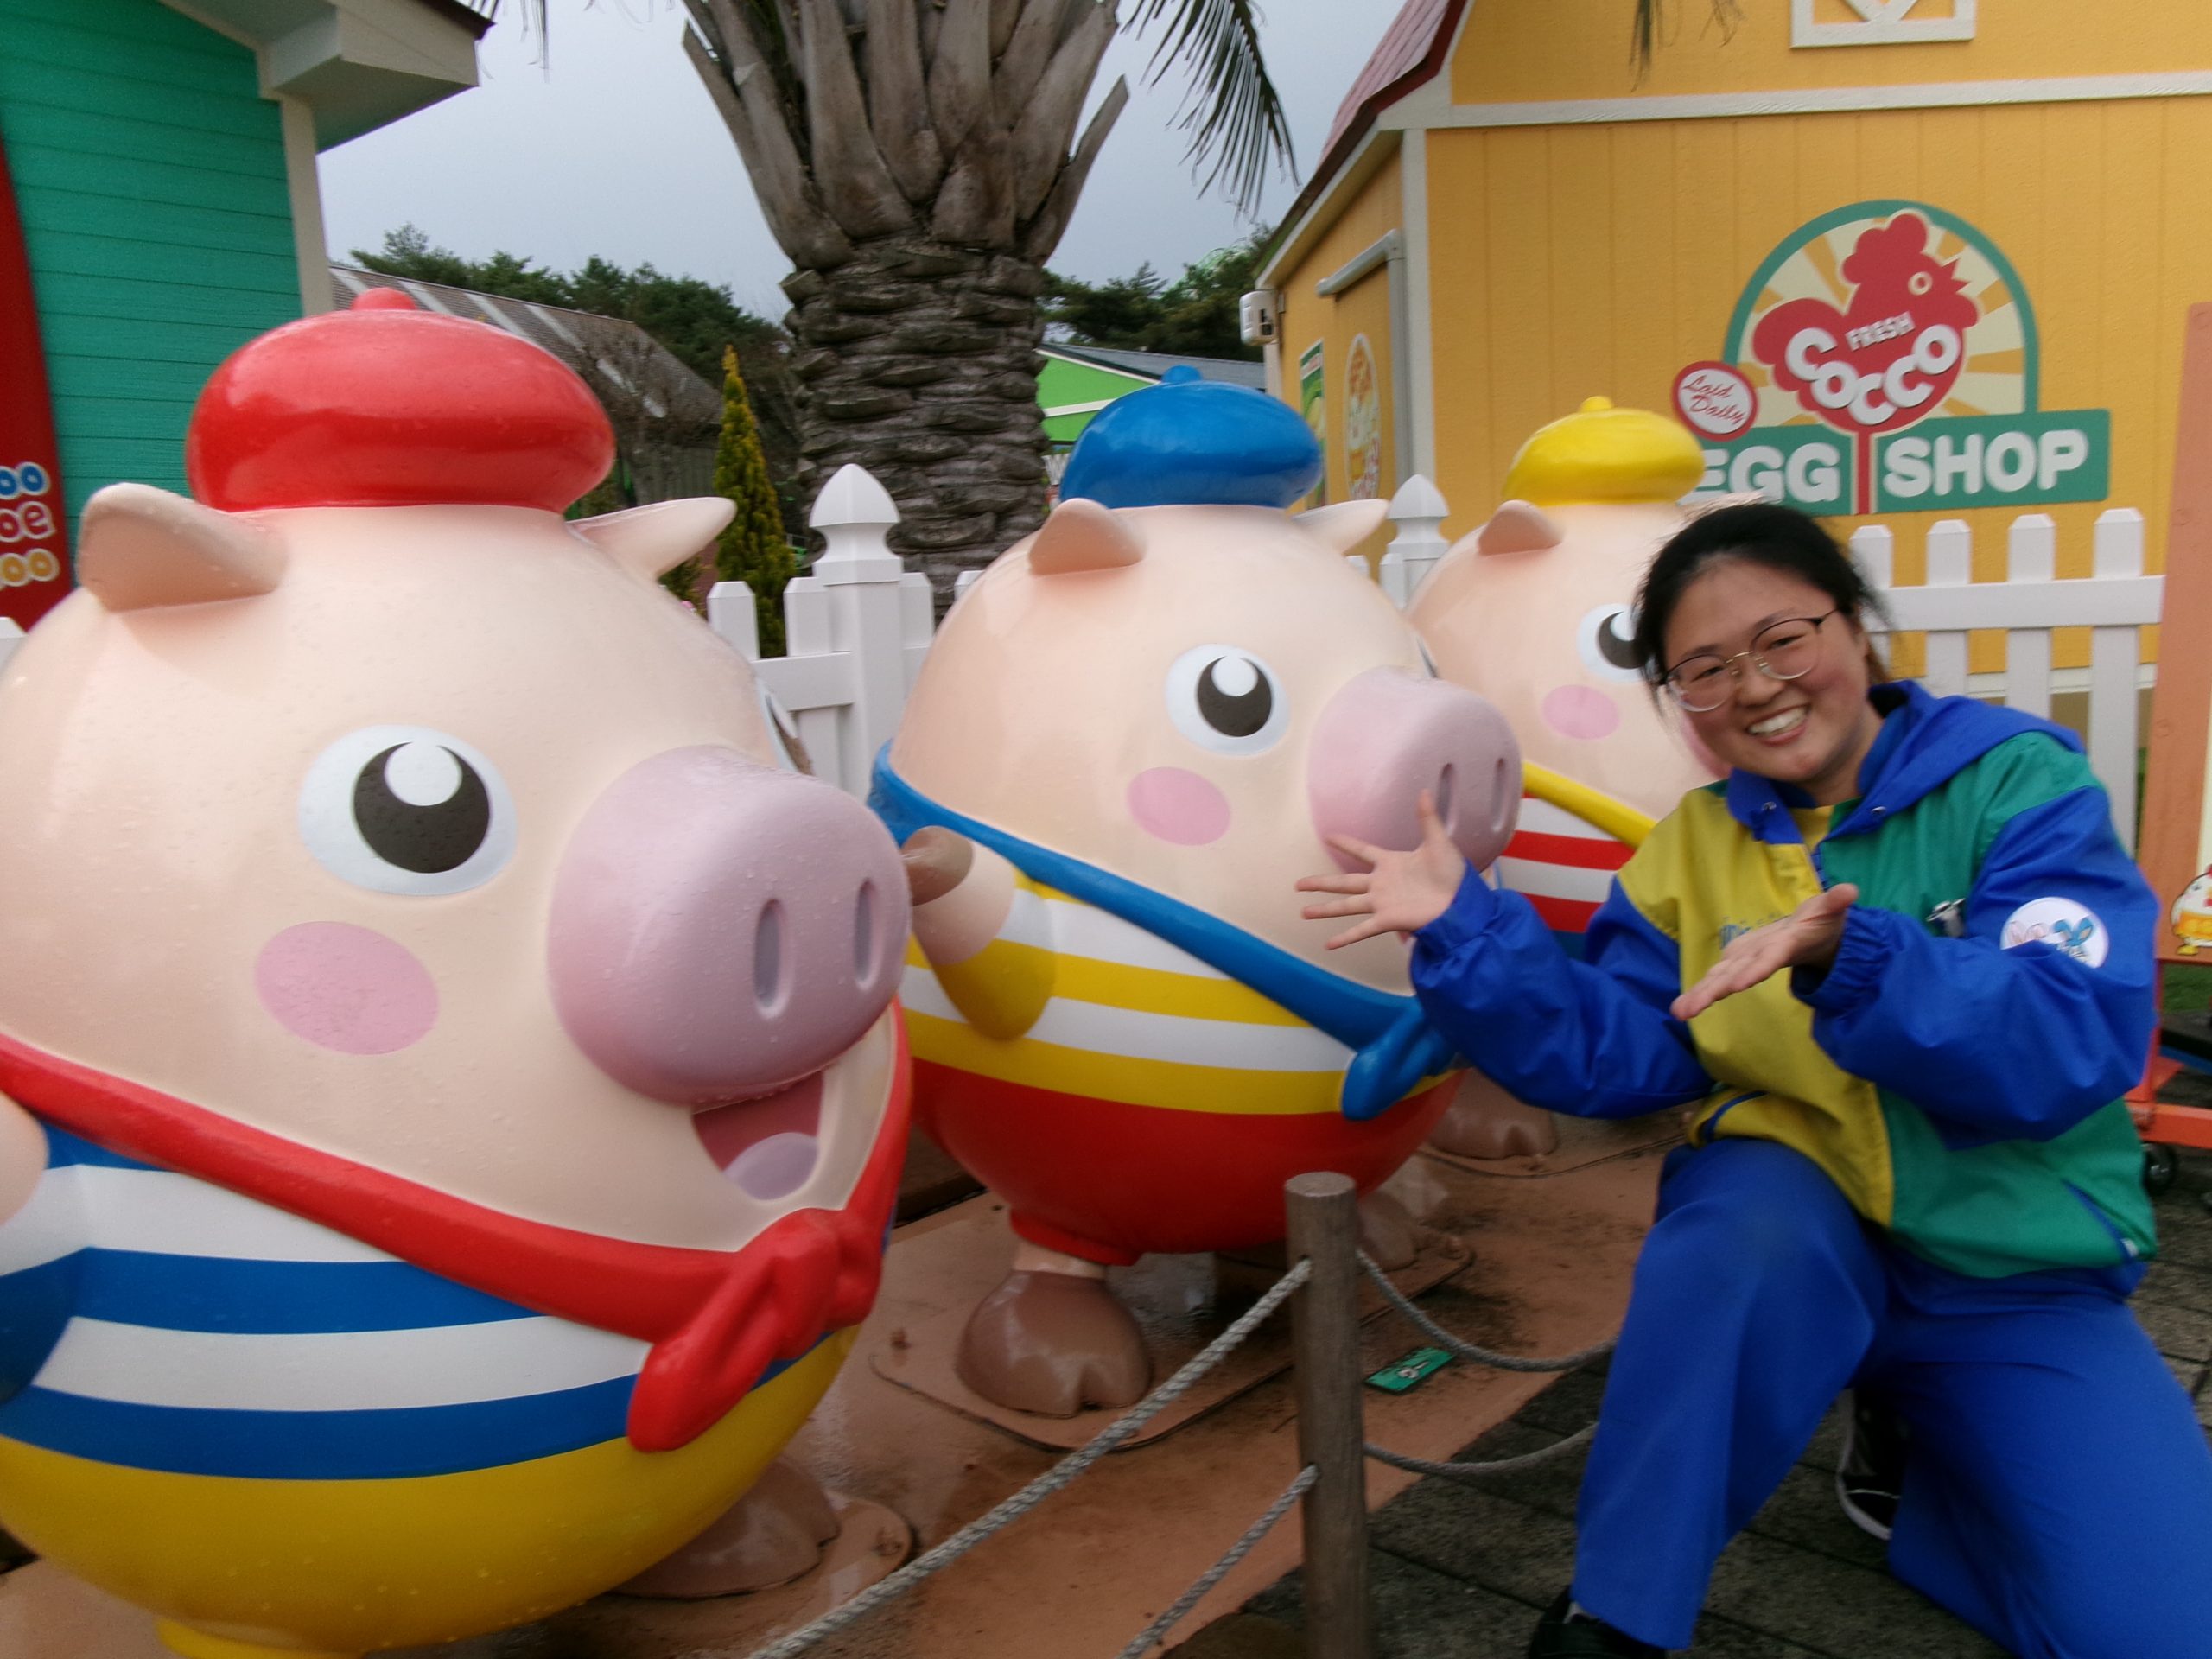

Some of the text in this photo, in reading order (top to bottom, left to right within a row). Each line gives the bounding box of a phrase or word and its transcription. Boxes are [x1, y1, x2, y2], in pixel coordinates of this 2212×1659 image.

[1845, 311, 1915, 351] FRESH
[1681, 374, 1737, 398] Laid
[1784, 327, 1961, 425] COCCO
[1690, 394, 1745, 425] Daily
[1678, 429, 2088, 505] EGG SHOP
